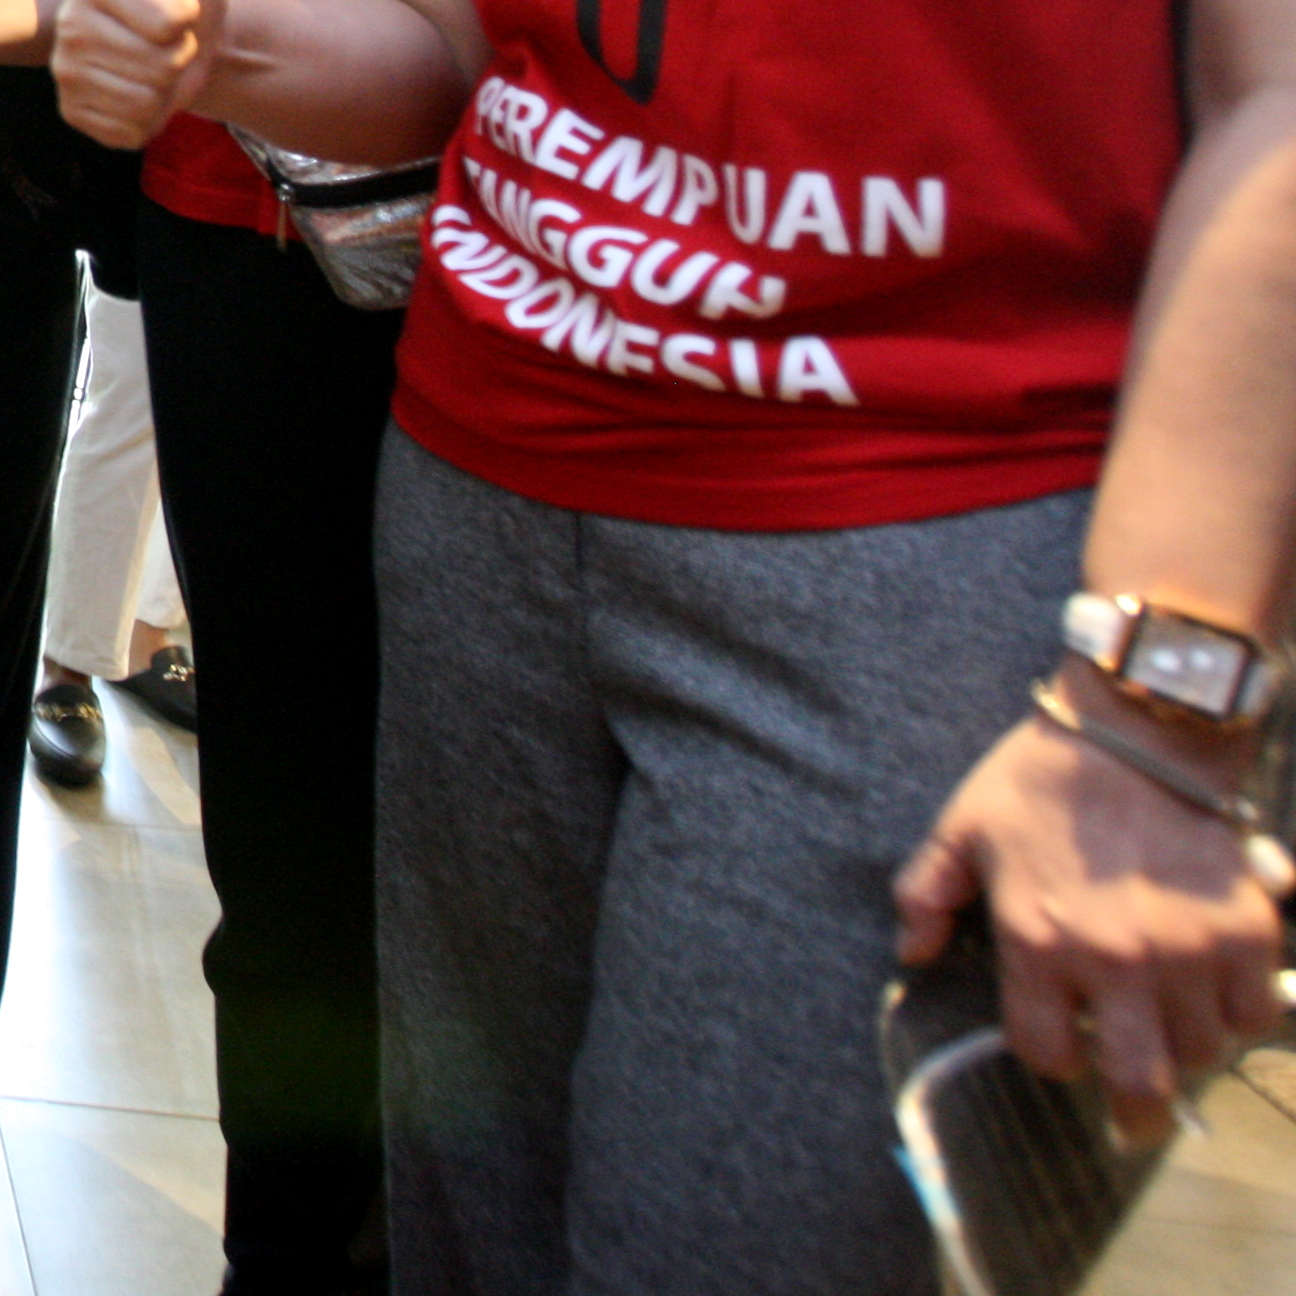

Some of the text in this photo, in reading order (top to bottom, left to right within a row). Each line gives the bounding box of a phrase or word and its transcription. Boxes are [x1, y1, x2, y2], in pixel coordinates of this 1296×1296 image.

[462, 156, 787, 321] TANGGUH
[474, 74, 948, 260] PEREMPUAN
[430, 204, 861, 408] INDONESIA
